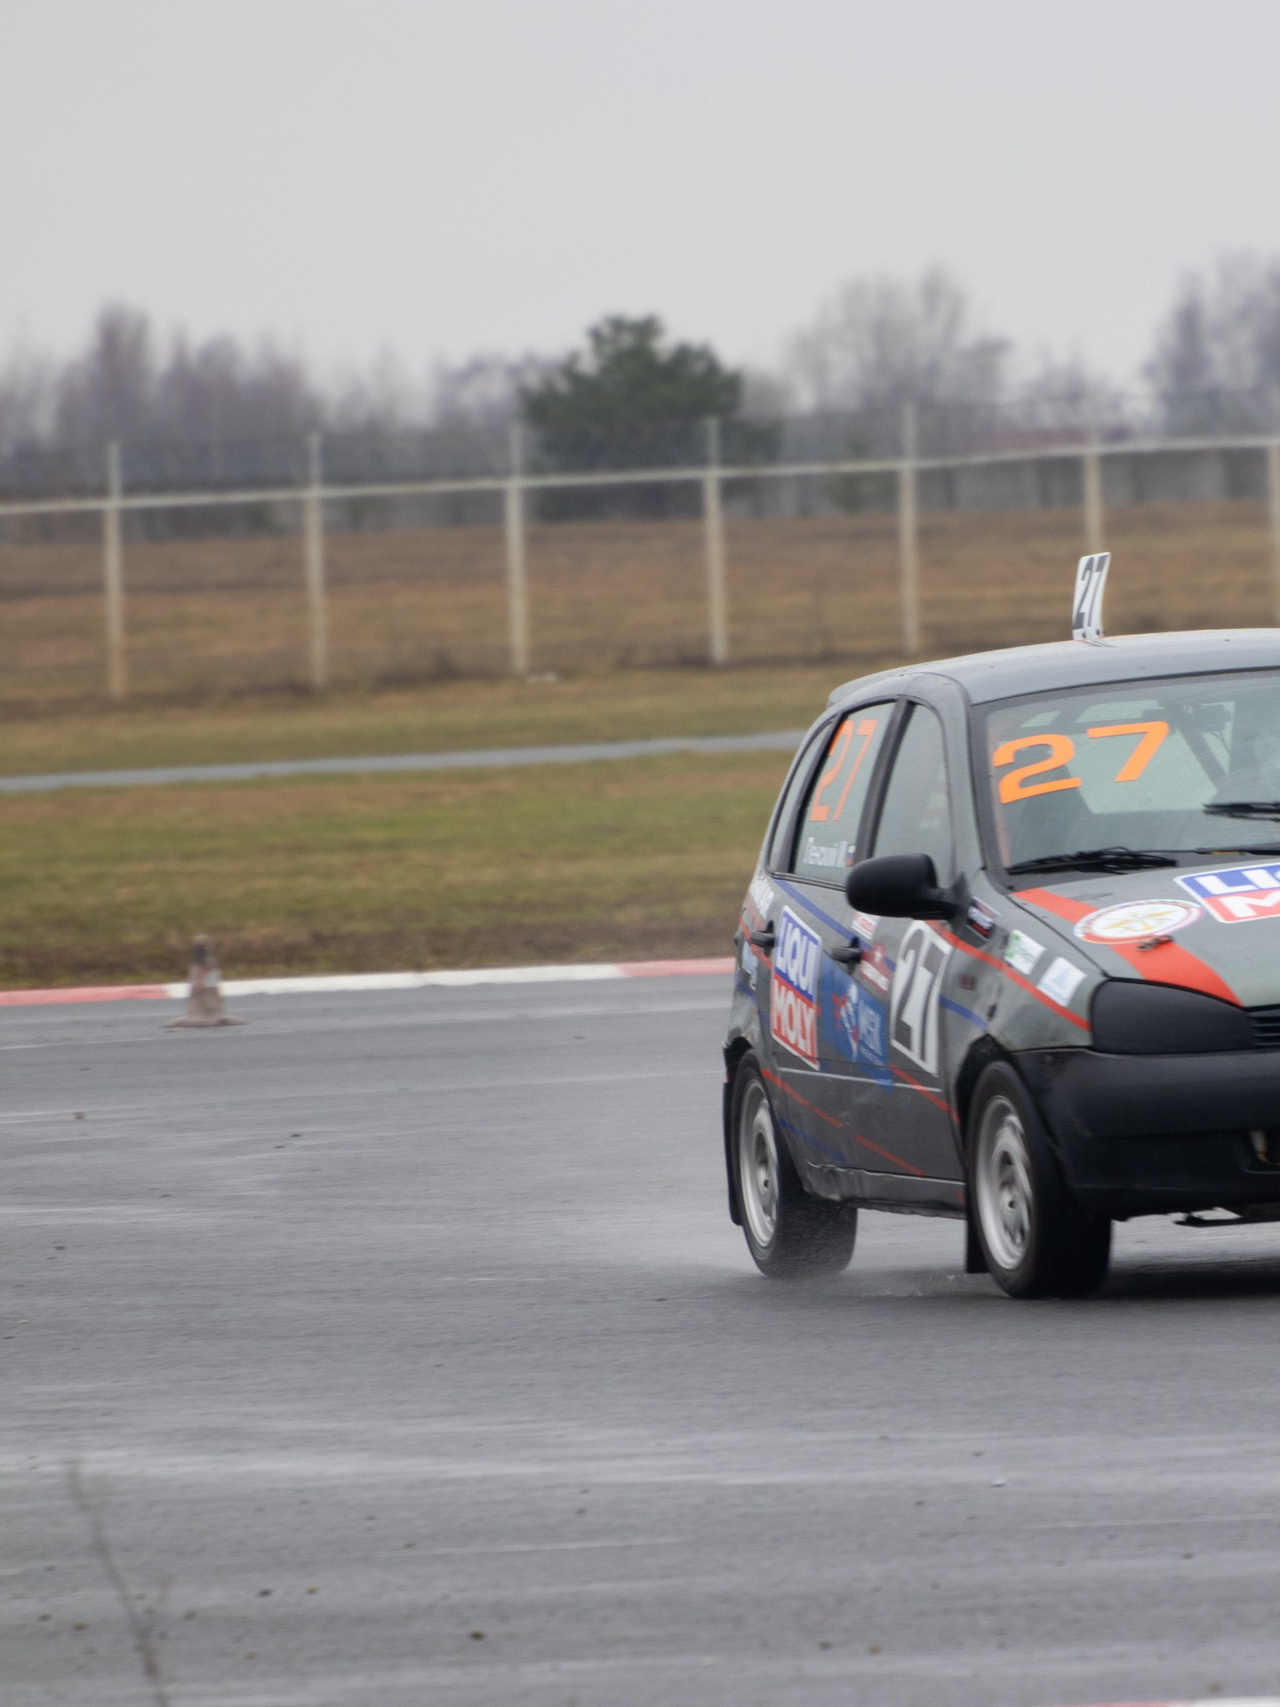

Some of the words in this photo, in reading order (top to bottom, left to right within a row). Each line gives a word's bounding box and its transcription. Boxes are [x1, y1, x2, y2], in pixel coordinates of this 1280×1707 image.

[1073, 555, 1108, 630] 27
[809, 719, 878, 821] 27
[993, 721, 1170, 804] 27
[776, 916, 818, 996] LIQUI
[895, 929, 946, 1063] 27
[773, 979, 815, 1054] MOLY
